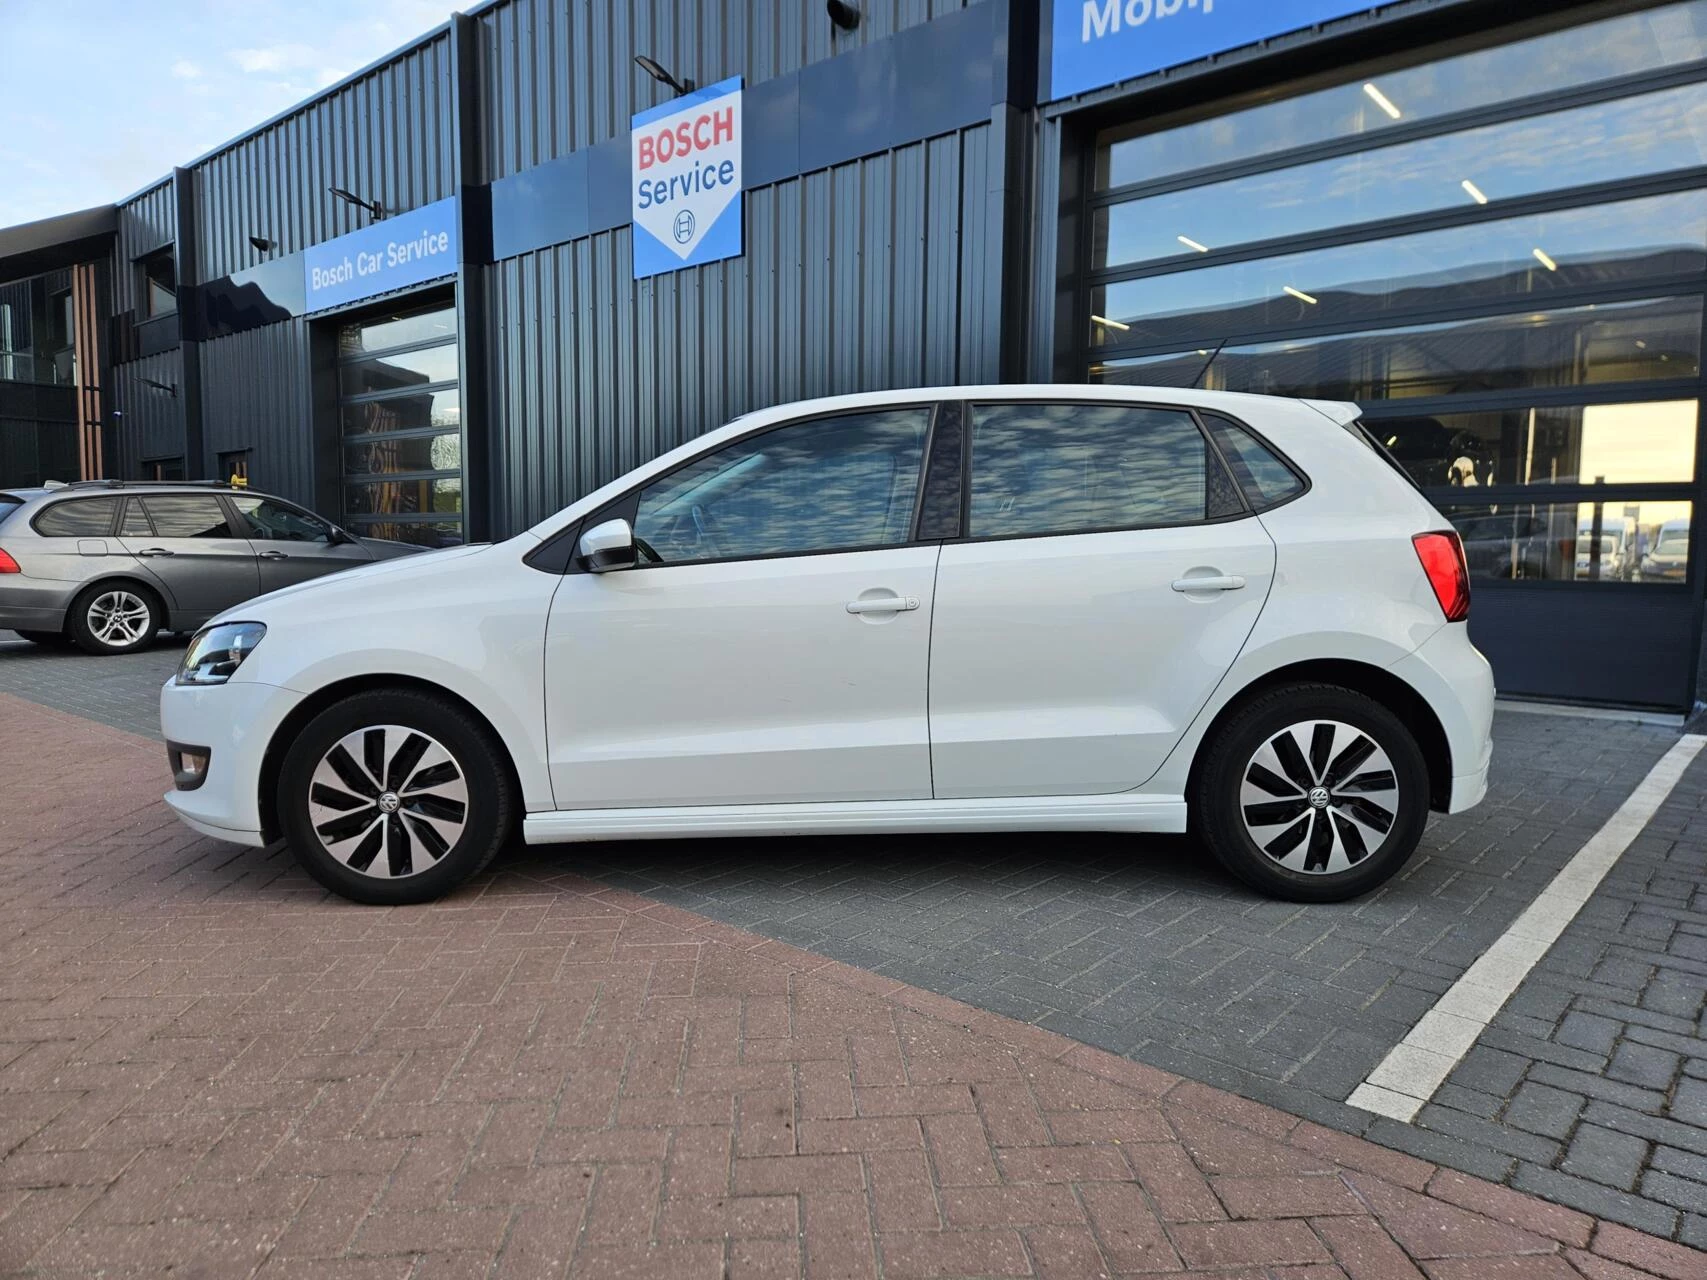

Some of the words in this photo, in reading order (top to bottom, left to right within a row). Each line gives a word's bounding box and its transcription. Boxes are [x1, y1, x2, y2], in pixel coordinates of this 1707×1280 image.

[639, 106, 733, 170] BOSCH
[638, 160, 734, 209] Service
[312, 257, 353, 290] Bosch
[357, 251, 383, 276] Car
[387, 230, 449, 268] Service
